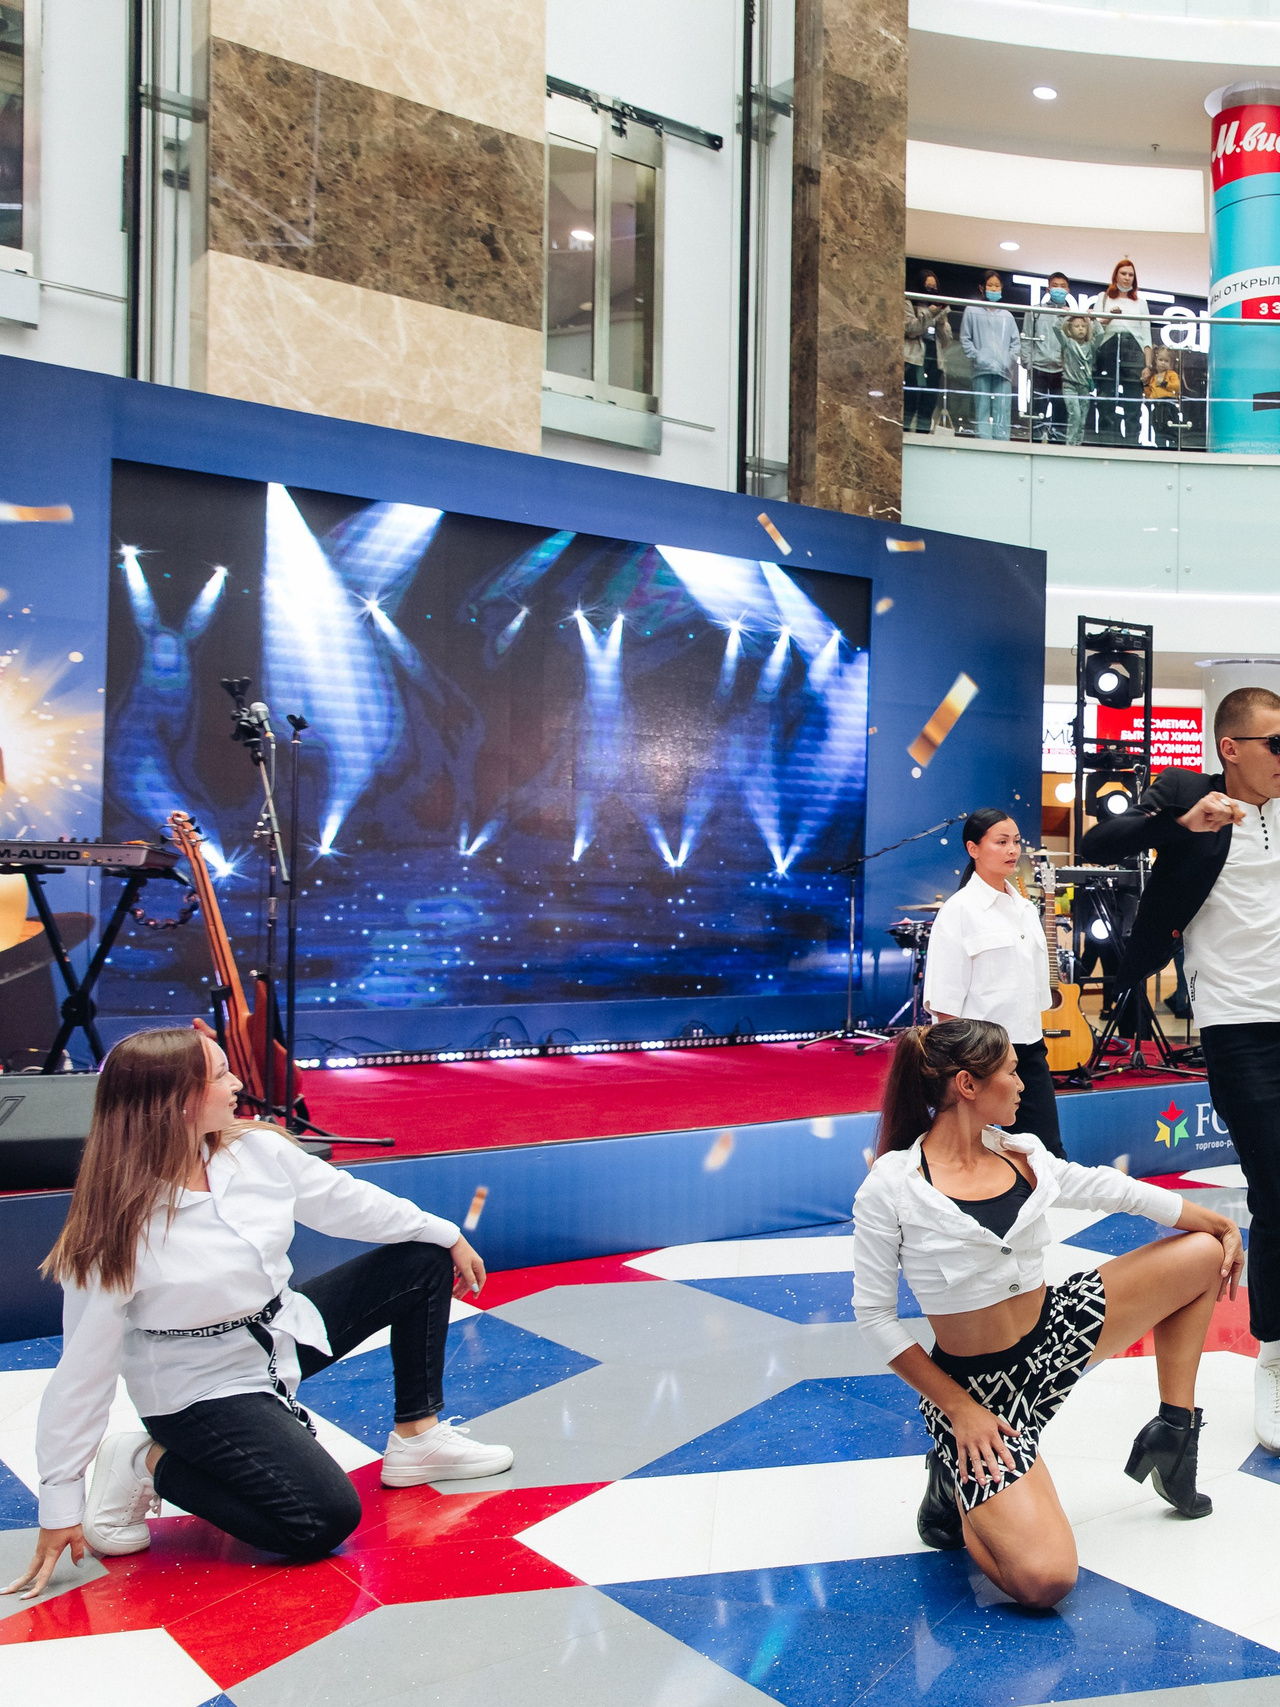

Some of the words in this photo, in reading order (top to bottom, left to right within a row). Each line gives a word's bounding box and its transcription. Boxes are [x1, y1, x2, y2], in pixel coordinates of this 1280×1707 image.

[1259, 302, 1269, 315] 3
[1170, 731, 1203, 742] ХИМИ
[1129, 743, 1201, 755] ПГУЗНИКИ
[1182, 756, 1203, 766] КОР
[0, 849, 80, 860] M-AUDIO
